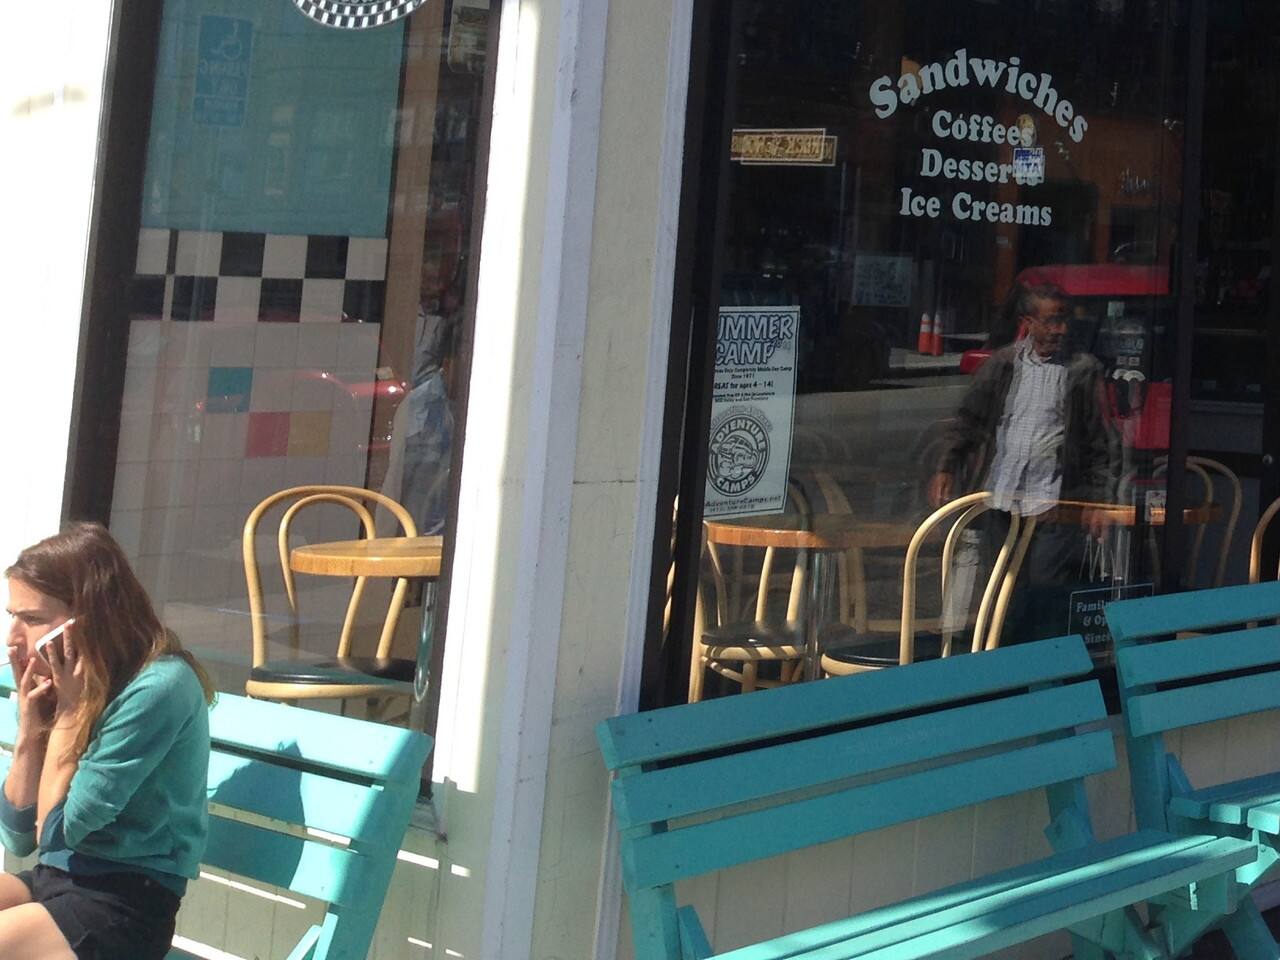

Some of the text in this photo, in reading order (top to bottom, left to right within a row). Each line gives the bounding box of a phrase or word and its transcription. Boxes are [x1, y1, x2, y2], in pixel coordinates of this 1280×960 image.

[868, 47, 1089, 144] Sandwiches
[931, 109, 1035, 147] Coffees
[899, 186, 1053, 227] Ice Creams
[718, 314, 795, 341] UMMER
[714, 341, 775, 366] CAMP
[711, 418, 766, 454] ADVENTURE
[716, 474, 755, 493] CAMPS
